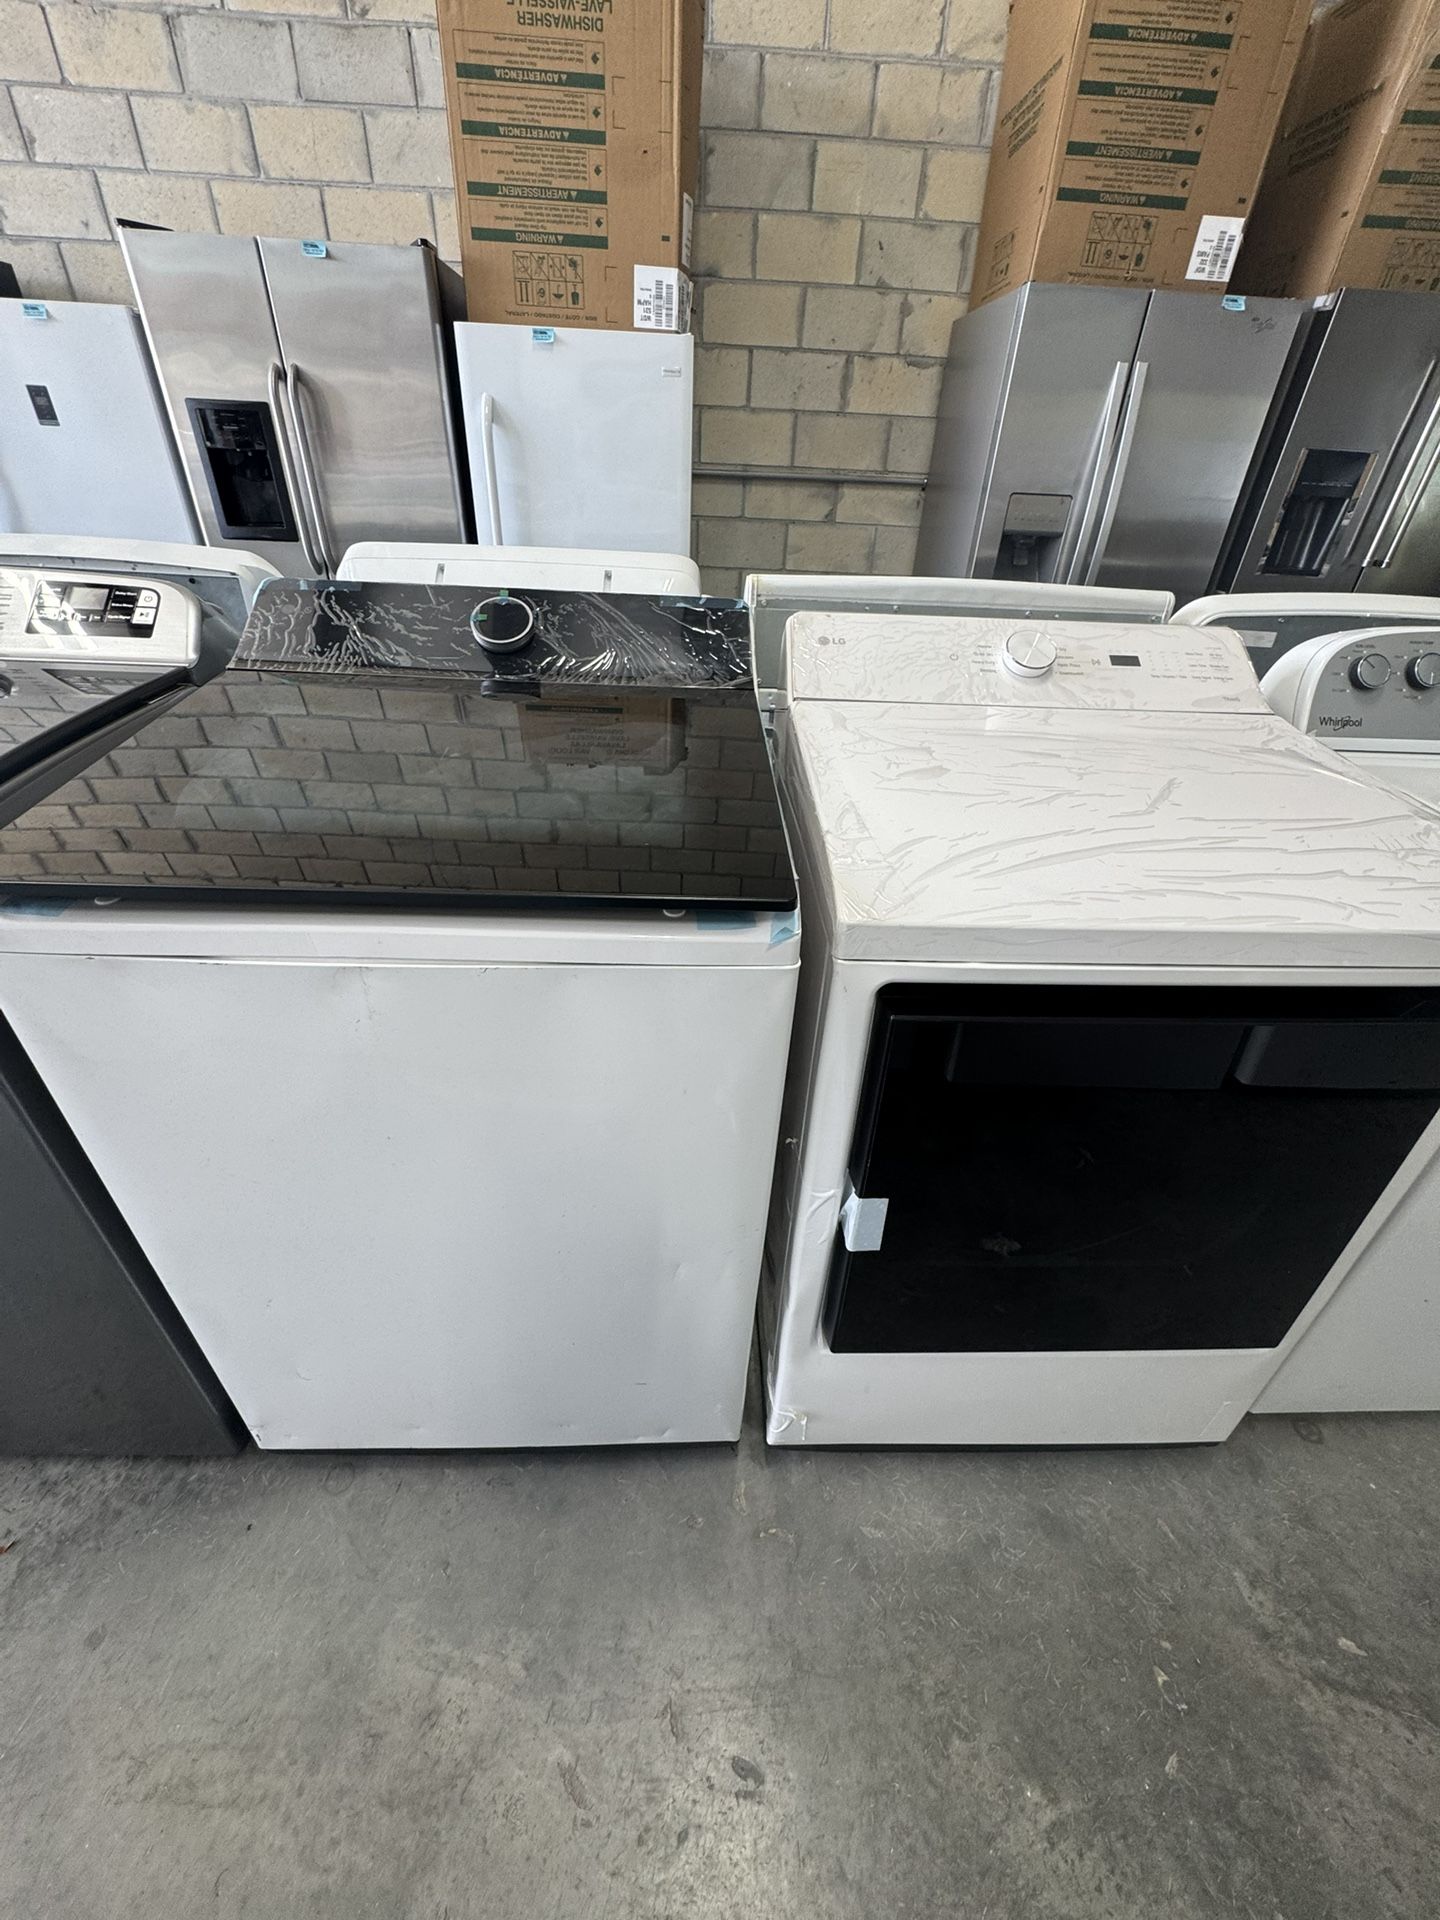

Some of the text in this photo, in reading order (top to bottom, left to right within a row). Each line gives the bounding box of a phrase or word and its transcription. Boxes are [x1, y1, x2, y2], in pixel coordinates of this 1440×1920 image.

[517, 11, 603, 32] DISHWASHER
[494, 68, 560, 83] ADVERTÊNCIA
[499, 126, 561, 139] ADVERTENCIA
[1095, 145, 1165, 159] AVERTISSEMENT
[497, 185, 568, 199] AVERTISSEMENT
[1100, 193, 1140, 204] WARNING
[515, 232, 558, 244] WARNING
[832, 637, 846, 645] LG
[1319, 716, 1363, 731] Whirlpool
